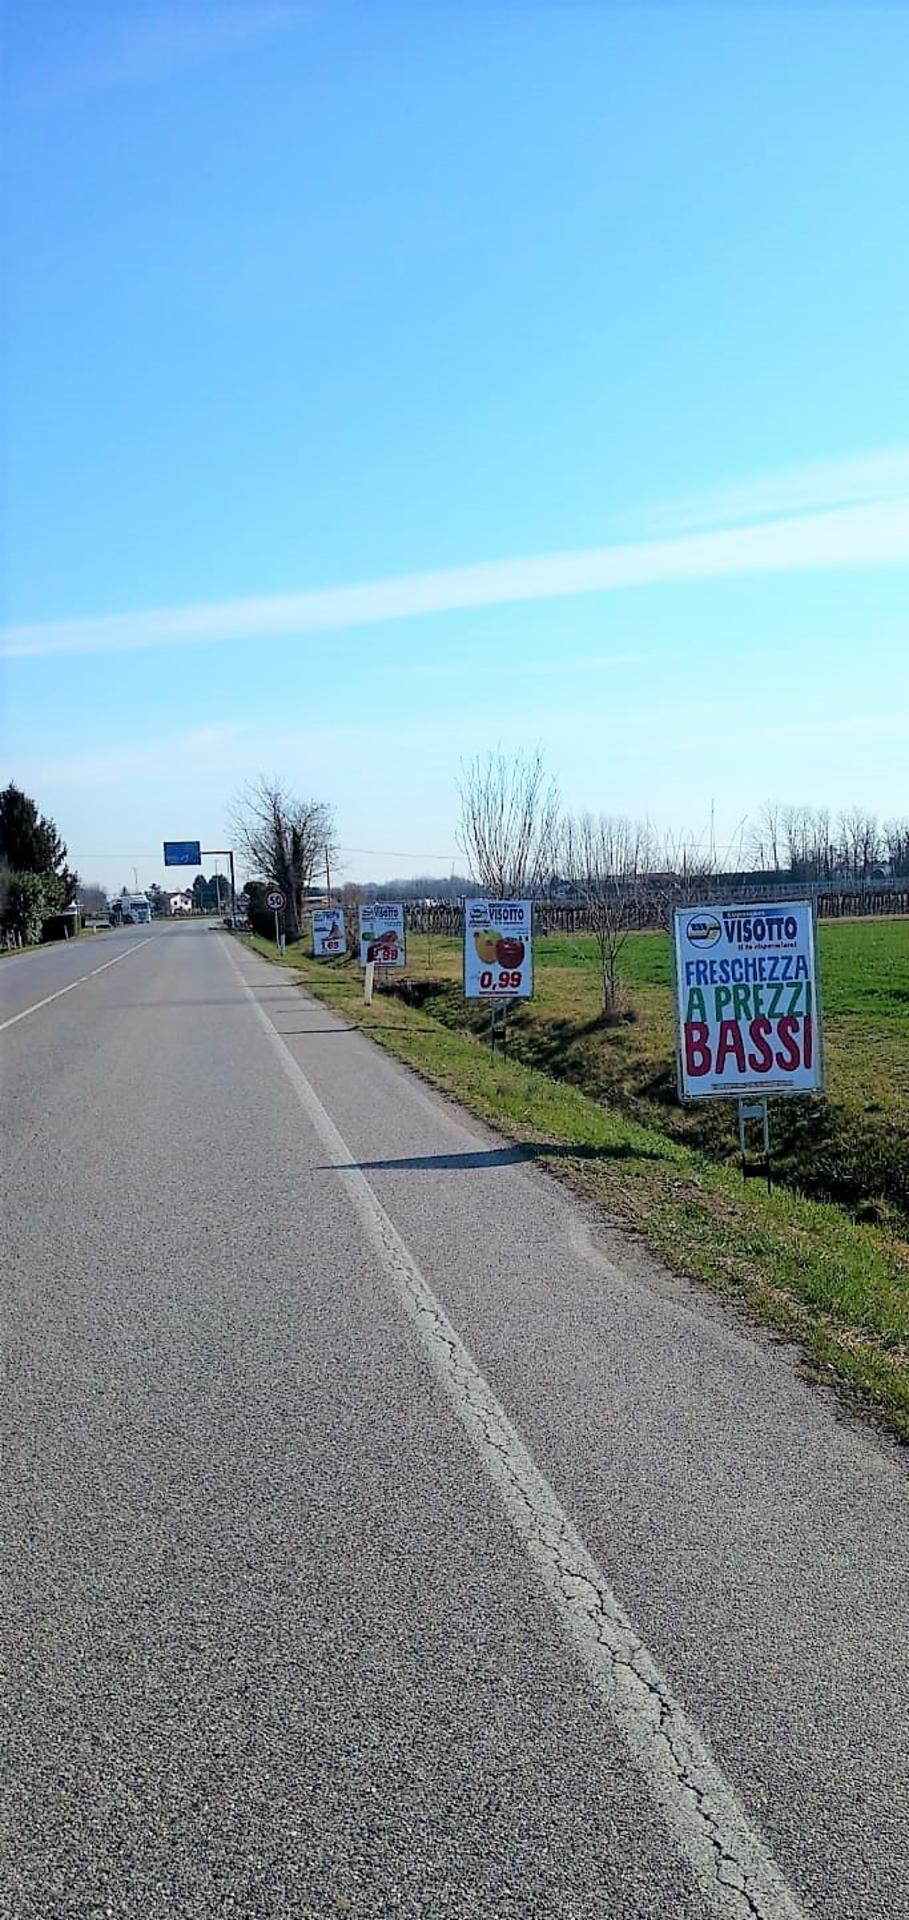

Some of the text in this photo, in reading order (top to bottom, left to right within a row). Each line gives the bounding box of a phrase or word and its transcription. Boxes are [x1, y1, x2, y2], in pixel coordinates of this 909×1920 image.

[269, 895, 283, 906] 50
[489, 908, 524, 921] VISOTTO
[724, 916, 797, 943] VISOTTO
[480, 971, 522, 990] 0,99
[686, 955, 808, 986] FRESCHEZZA
[687, 982, 812, 1022] A PREZZI
[684, 1015, 812, 1077] BASSI
